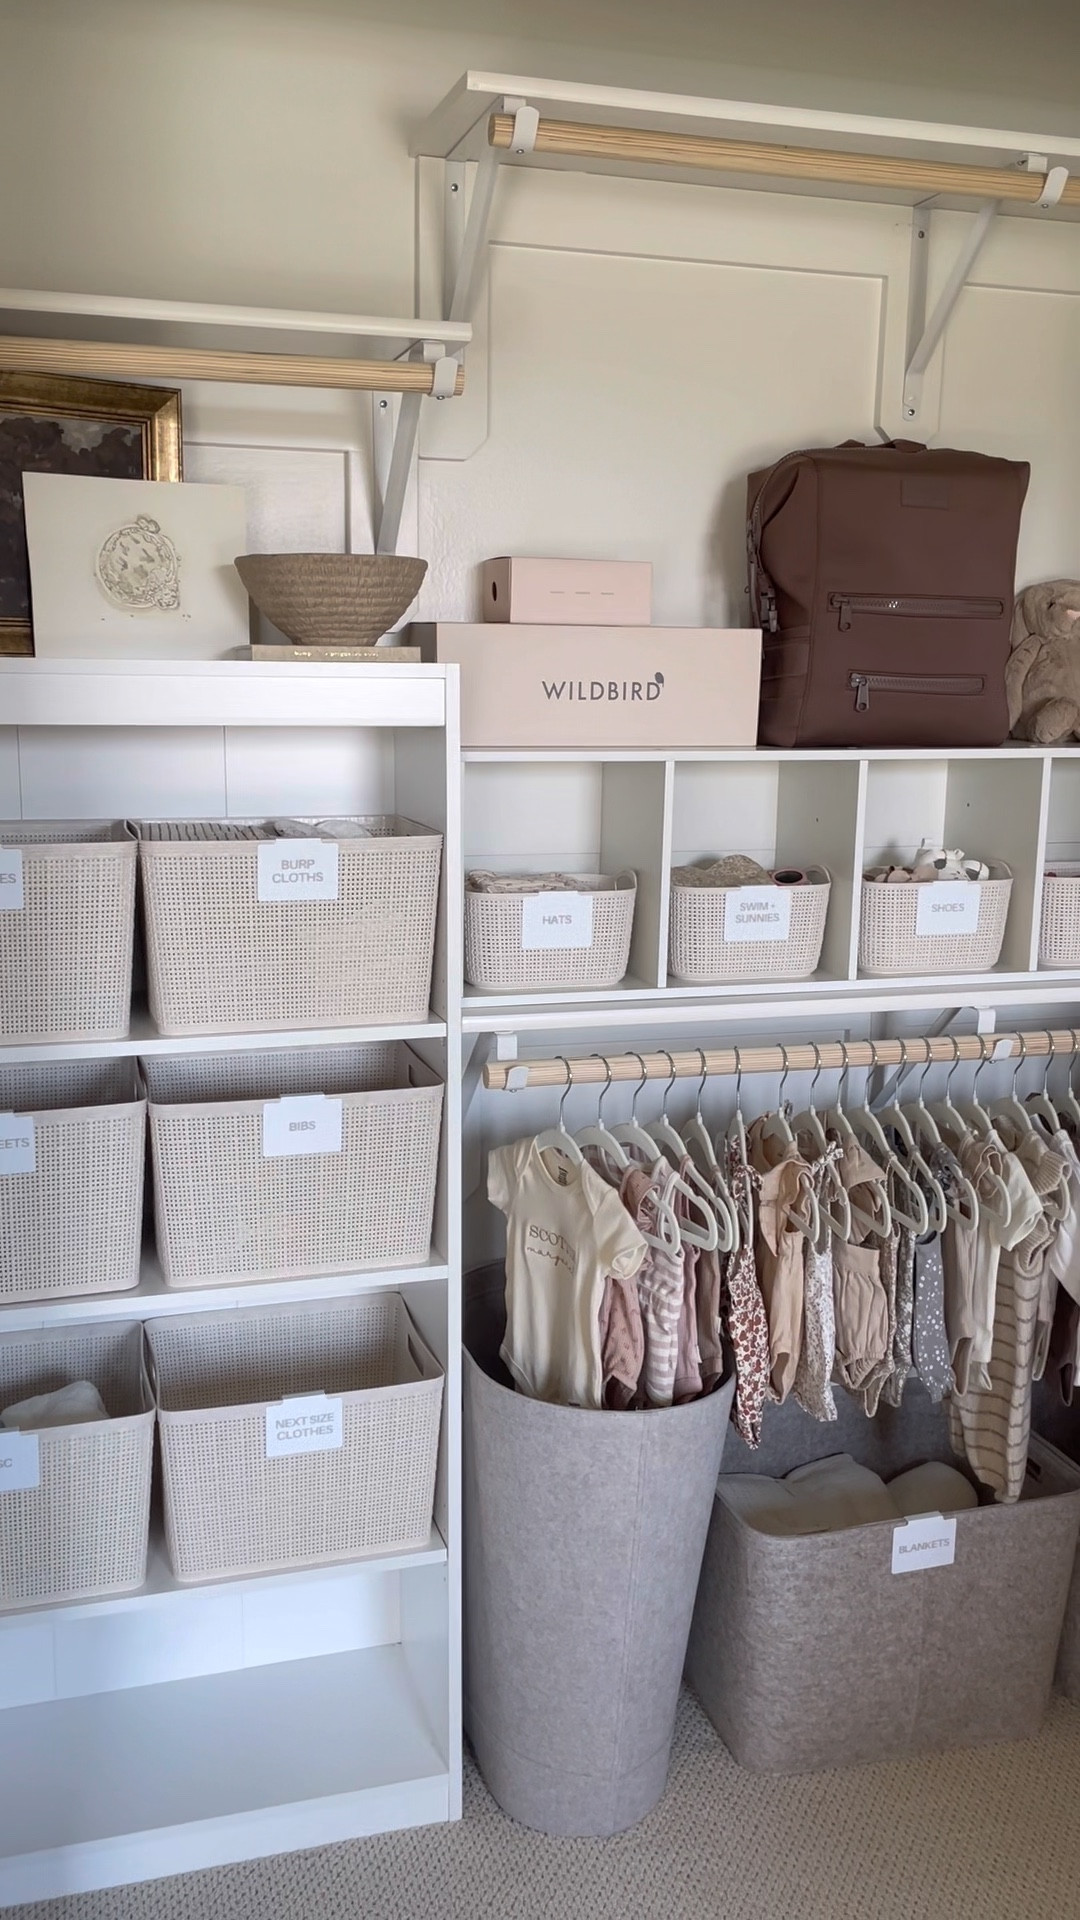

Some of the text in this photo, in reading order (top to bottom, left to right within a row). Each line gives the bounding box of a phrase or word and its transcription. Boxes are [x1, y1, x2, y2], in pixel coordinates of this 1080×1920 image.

[541, 680, 661, 701] WILDBIRD
[281, 859, 315, 870] BURP
[272, 871, 324, 883] CLOTHS
[740, 902, 769, 912] SWIM
[931, 903, 965, 913] SHOES
[542, 914, 573, 925] HATS
[735, 912, 780, 924] SUNNIES
[289, 1120, 316, 1132] BIBS
[275, 1412, 334, 1430] NEXT SIZE
[276, 1425, 334, 1441] CLOTHES
[898, 1538, 951, 1554] BLANKETS
